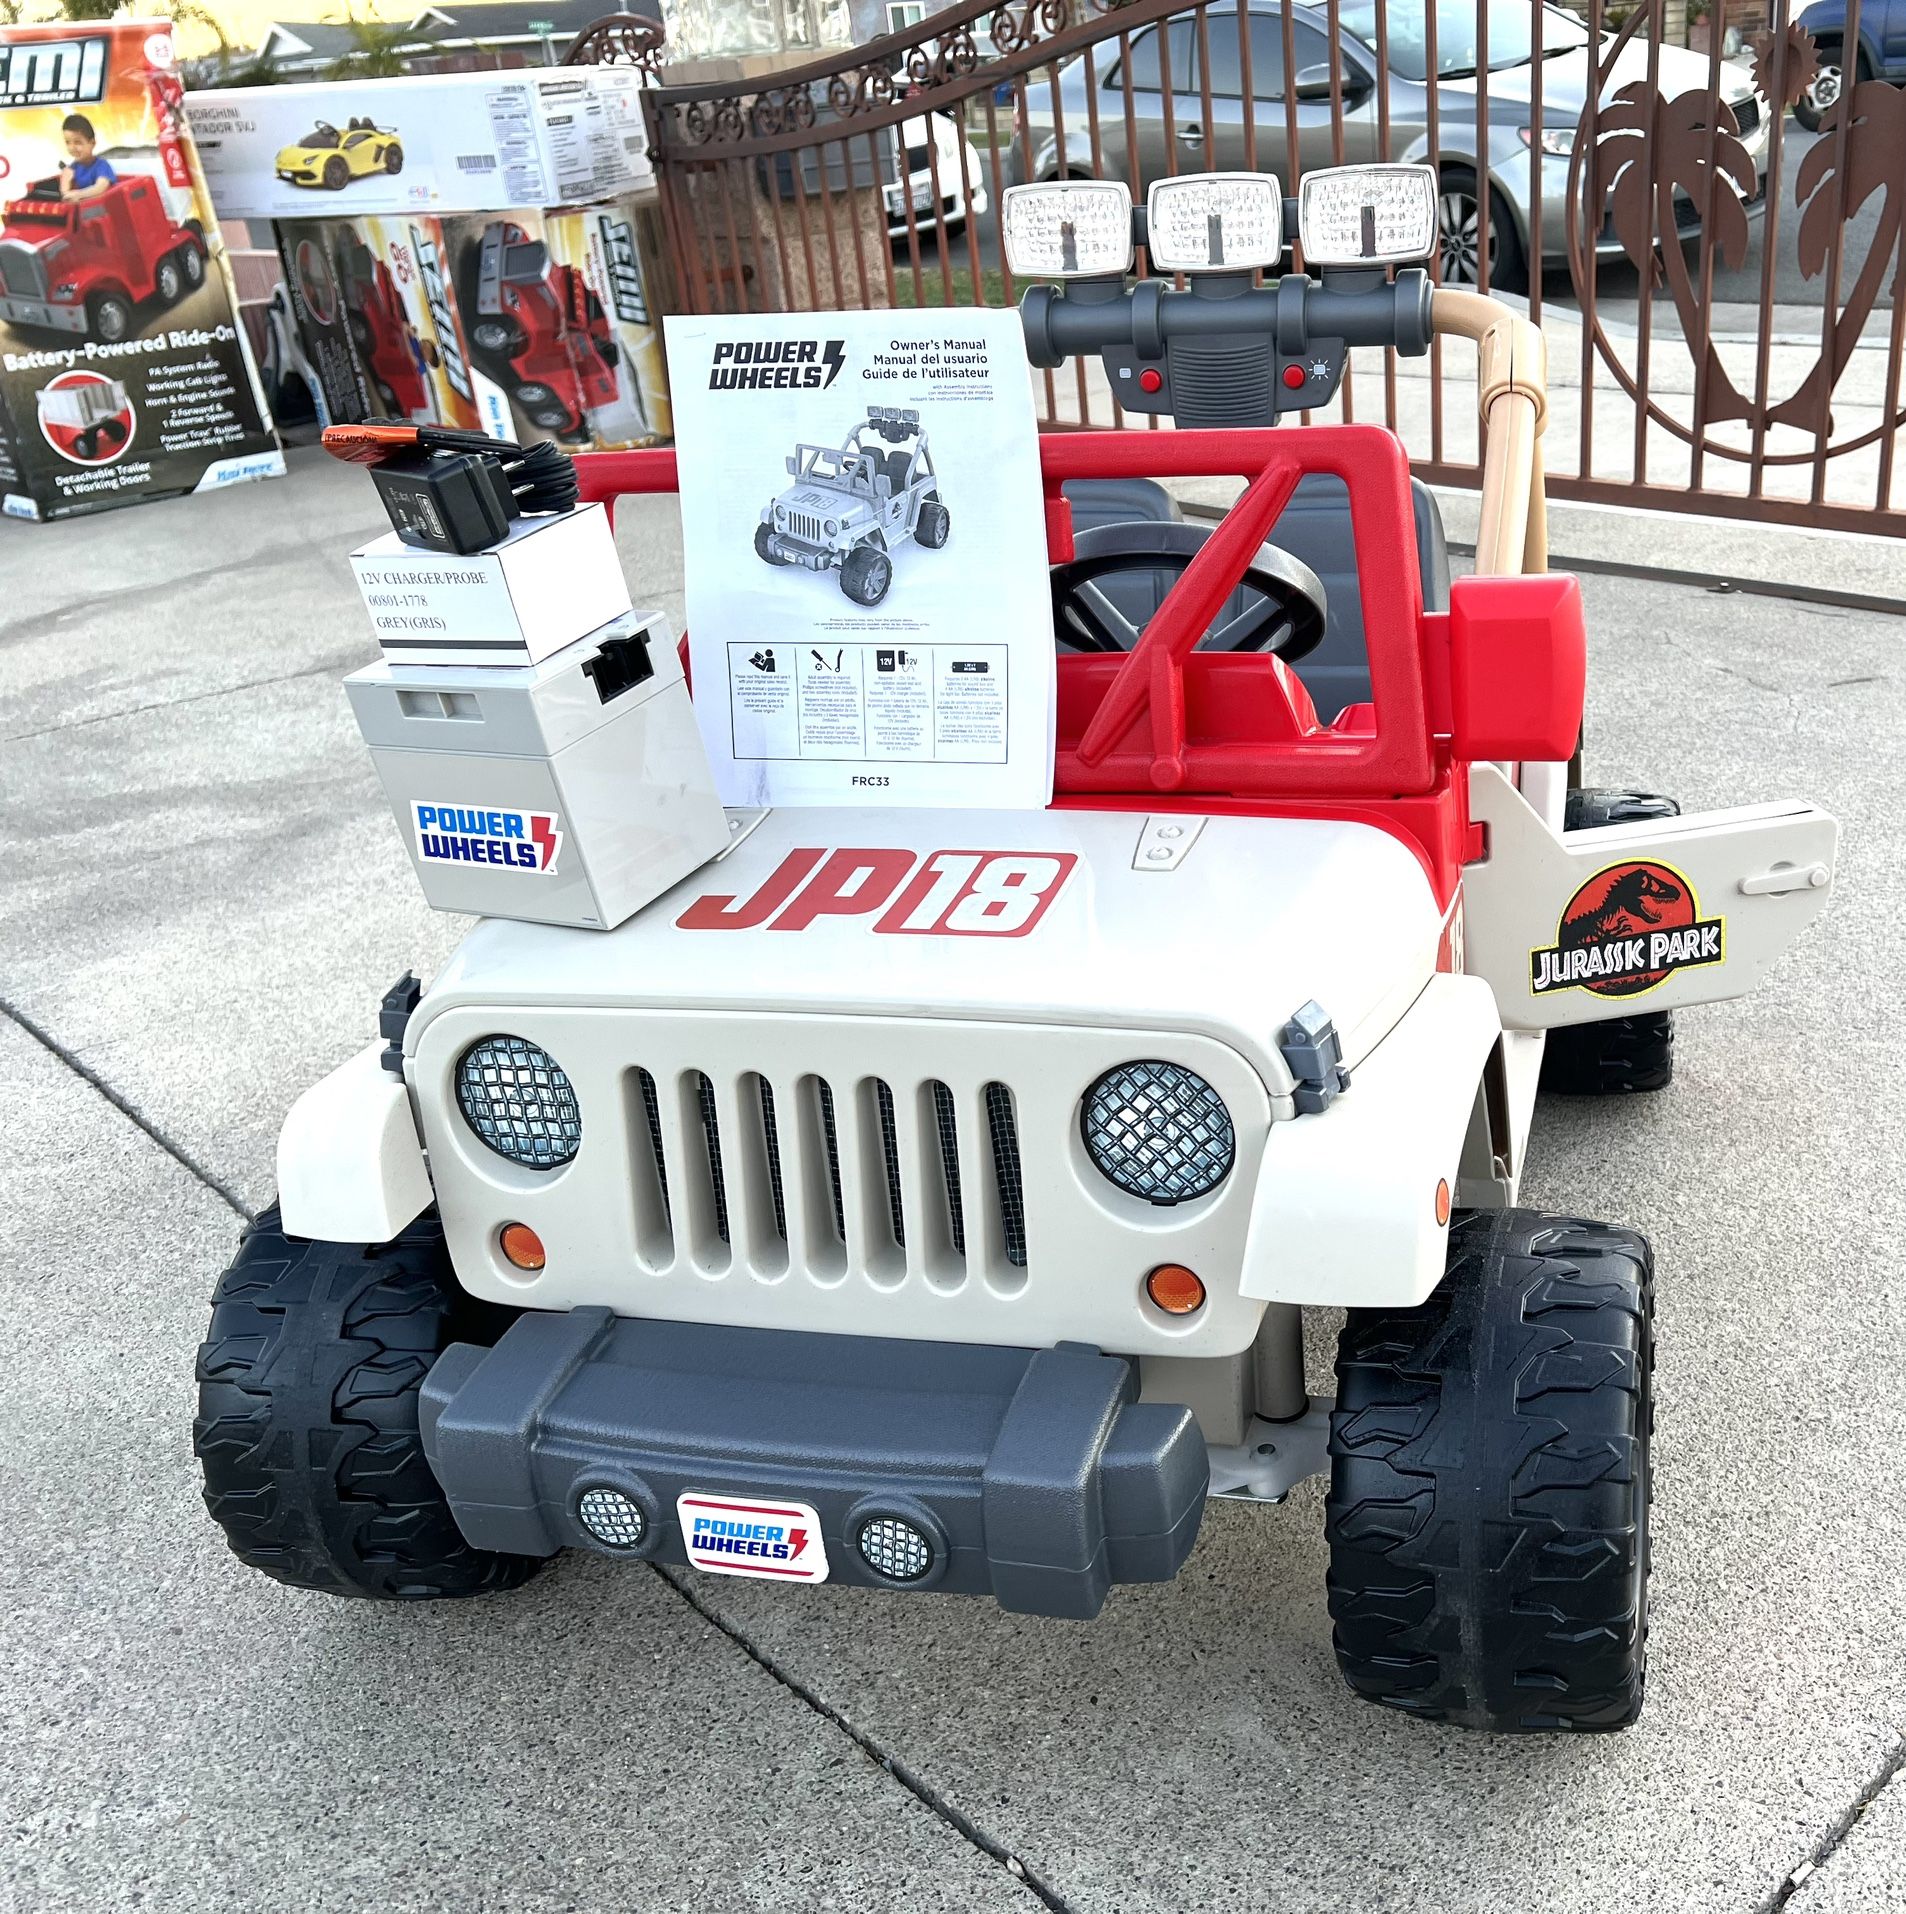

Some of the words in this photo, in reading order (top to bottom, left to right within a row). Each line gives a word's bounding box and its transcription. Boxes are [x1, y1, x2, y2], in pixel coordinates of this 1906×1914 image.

[168, 324, 235, 350] Ride-On
[890, 339, 940, 351] Owner's
[943, 339, 987, 351] Manual
[3, 333, 168, 372] Battery-Powered
[712, 340, 817, 365] POWER
[873, 353, 917, 365] Manual
[920, 353, 941, 365] del
[943, 353, 988, 365] usuario
[148, 367, 161, 377] PA
[162, 363, 195, 376] System
[196, 360, 220, 371] Radio
[862, 368, 899, 380] Guide
[902, 368, 919, 379] de
[921, 367, 990, 379] l'utilisateur
[146, 379, 185, 392] Working
[708, 366, 822, 390] WHEELS
[145, 396, 169, 408] Horn
[169, 394, 177, 404] &
[177, 391, 208, 404] Engine
[170, 409, 177, 419] 2
[177, 403, 215, 418] Forward
[215, 402, 224, 412] &
[162, 419, 168, 429] 1
[169, 416, 205, 428] Reverse
[160, 432, 189, 444] Power
[55, 468, 116, 487] Detachable
[116, 461, 151, 476] Trailer
[63, 485, 73, 496] &
[73, 477, 119, 495] Working
[120, 472, 151, 487] Doors
[361, 571, 380, 584] 12V
[383, 571, 489, 585] CHARGER/PROBE
[368, 594, 428, 607] 00801-1778
[376, 616, 447, 632] GREY(GRIS)
[879, 657, 892, 666] 12V
[906, 658, 918, 666] 12V
[851, 776, 890, 787] FRC33
[417, 805, 525, 839] POWER
[421, 833, 537, 868] WHEELS
[1534, 939, 1645, 990] JURASSIC
[1649, 925, 1720, 970] PARK
[694, 1518, 784, 1541] POWER
[692, 1534, 789, 1559] WHEELS
